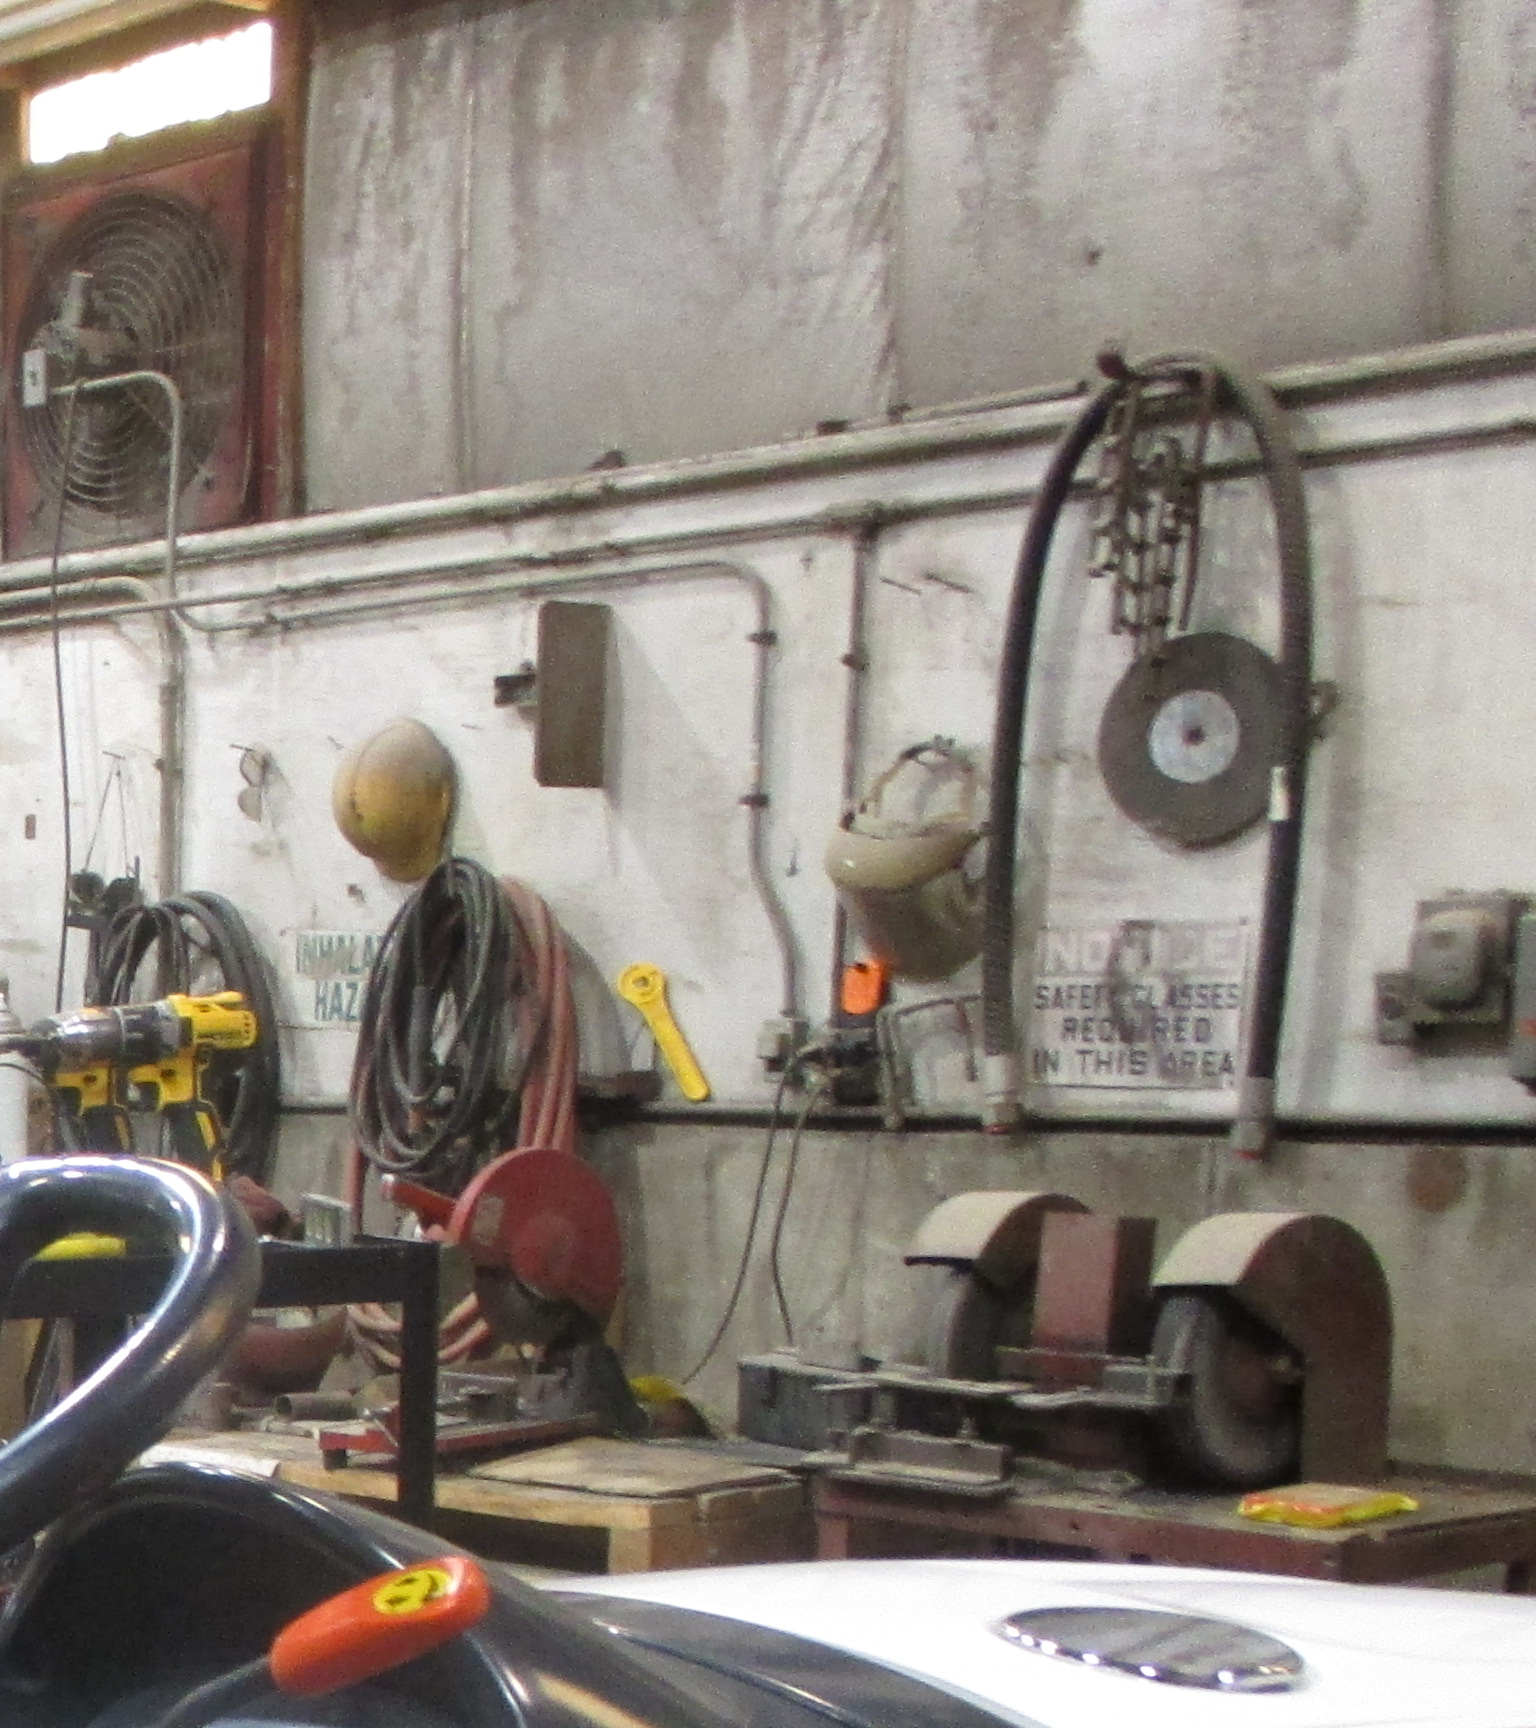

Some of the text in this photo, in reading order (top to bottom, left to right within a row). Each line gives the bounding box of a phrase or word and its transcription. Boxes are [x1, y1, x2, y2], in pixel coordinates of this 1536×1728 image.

[314, 980, 360, 1021] HAZ
[1033, 1050, 1235, 1077] IN THIS AREA
